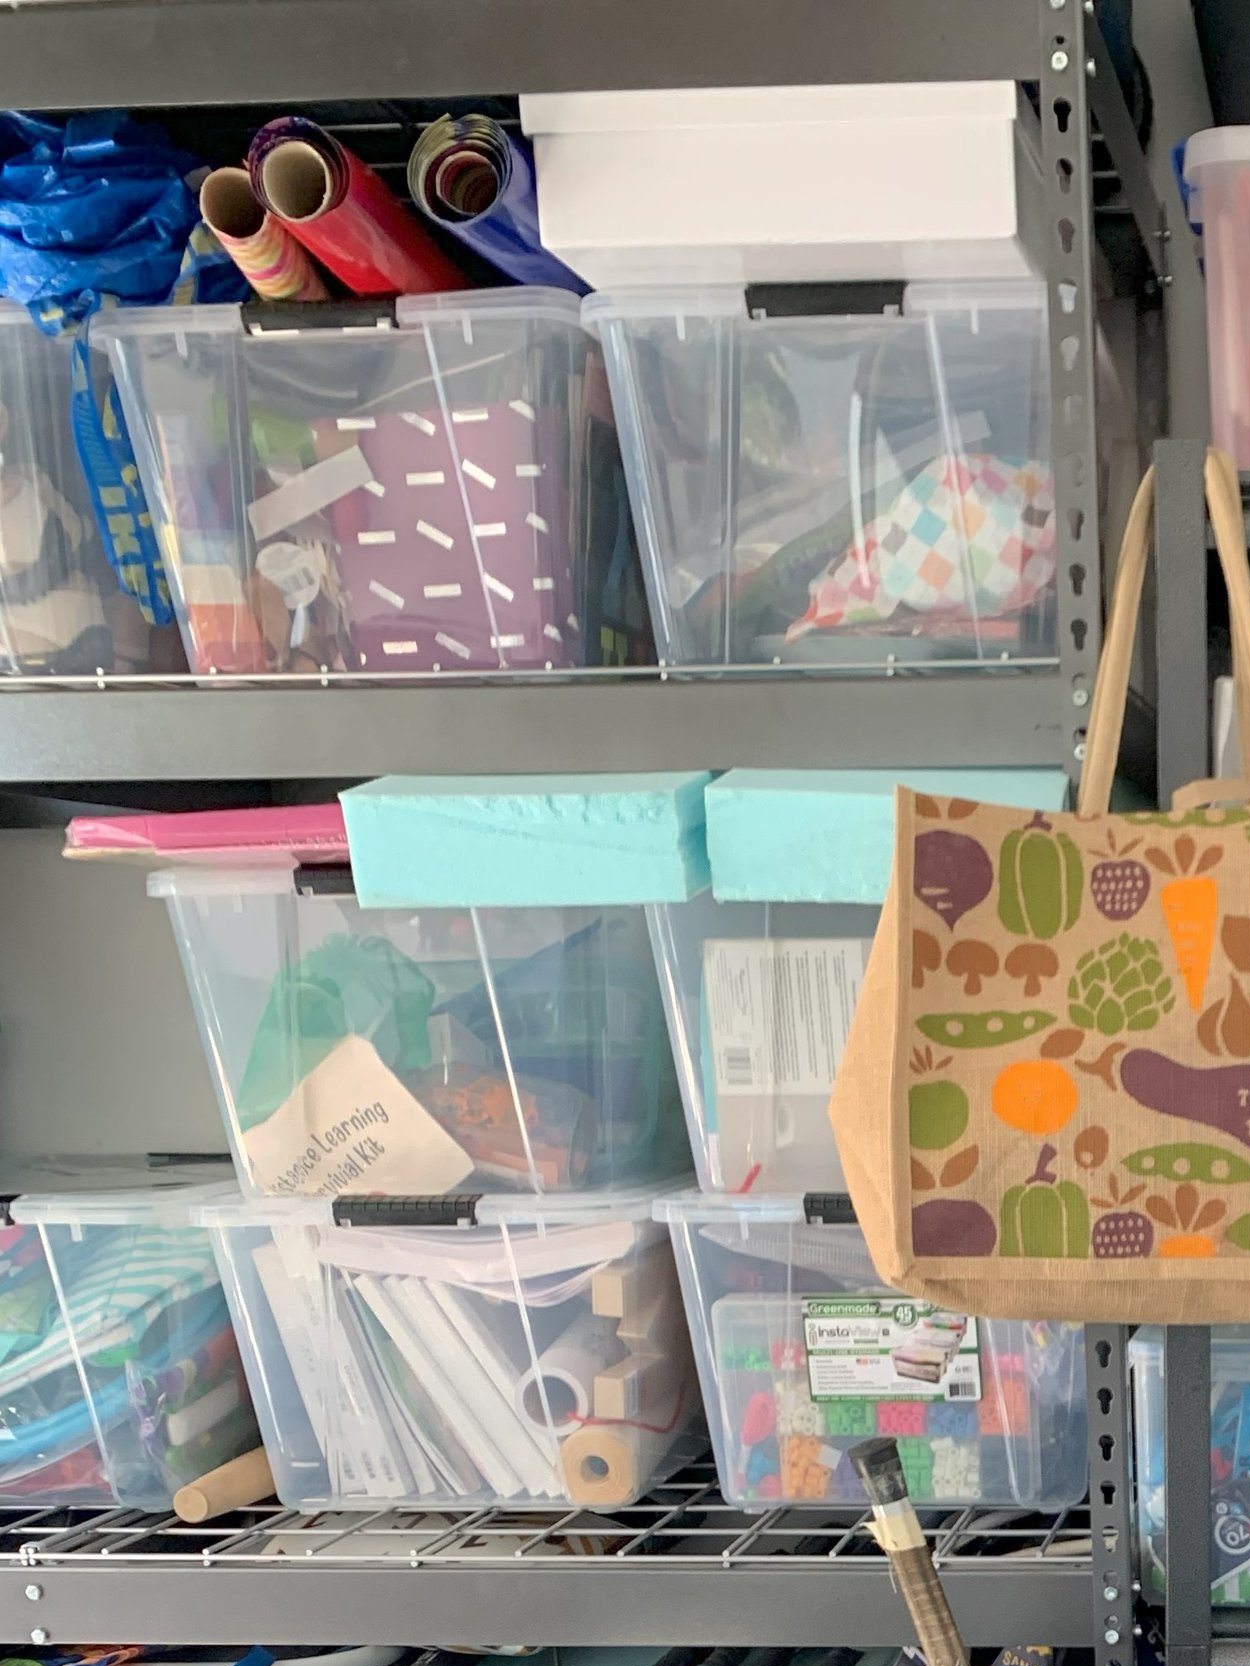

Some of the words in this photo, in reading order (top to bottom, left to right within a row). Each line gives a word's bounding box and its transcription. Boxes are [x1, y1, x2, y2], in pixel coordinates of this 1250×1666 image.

[268, 1147, 322, 1194] istance
[309, 1101, 390, 1155] Learning
[352, 1136, 386, 1167] Kit
[808, 1303, 880, 1315] Greenmade
[895, 1304, 913, 1323] 45
